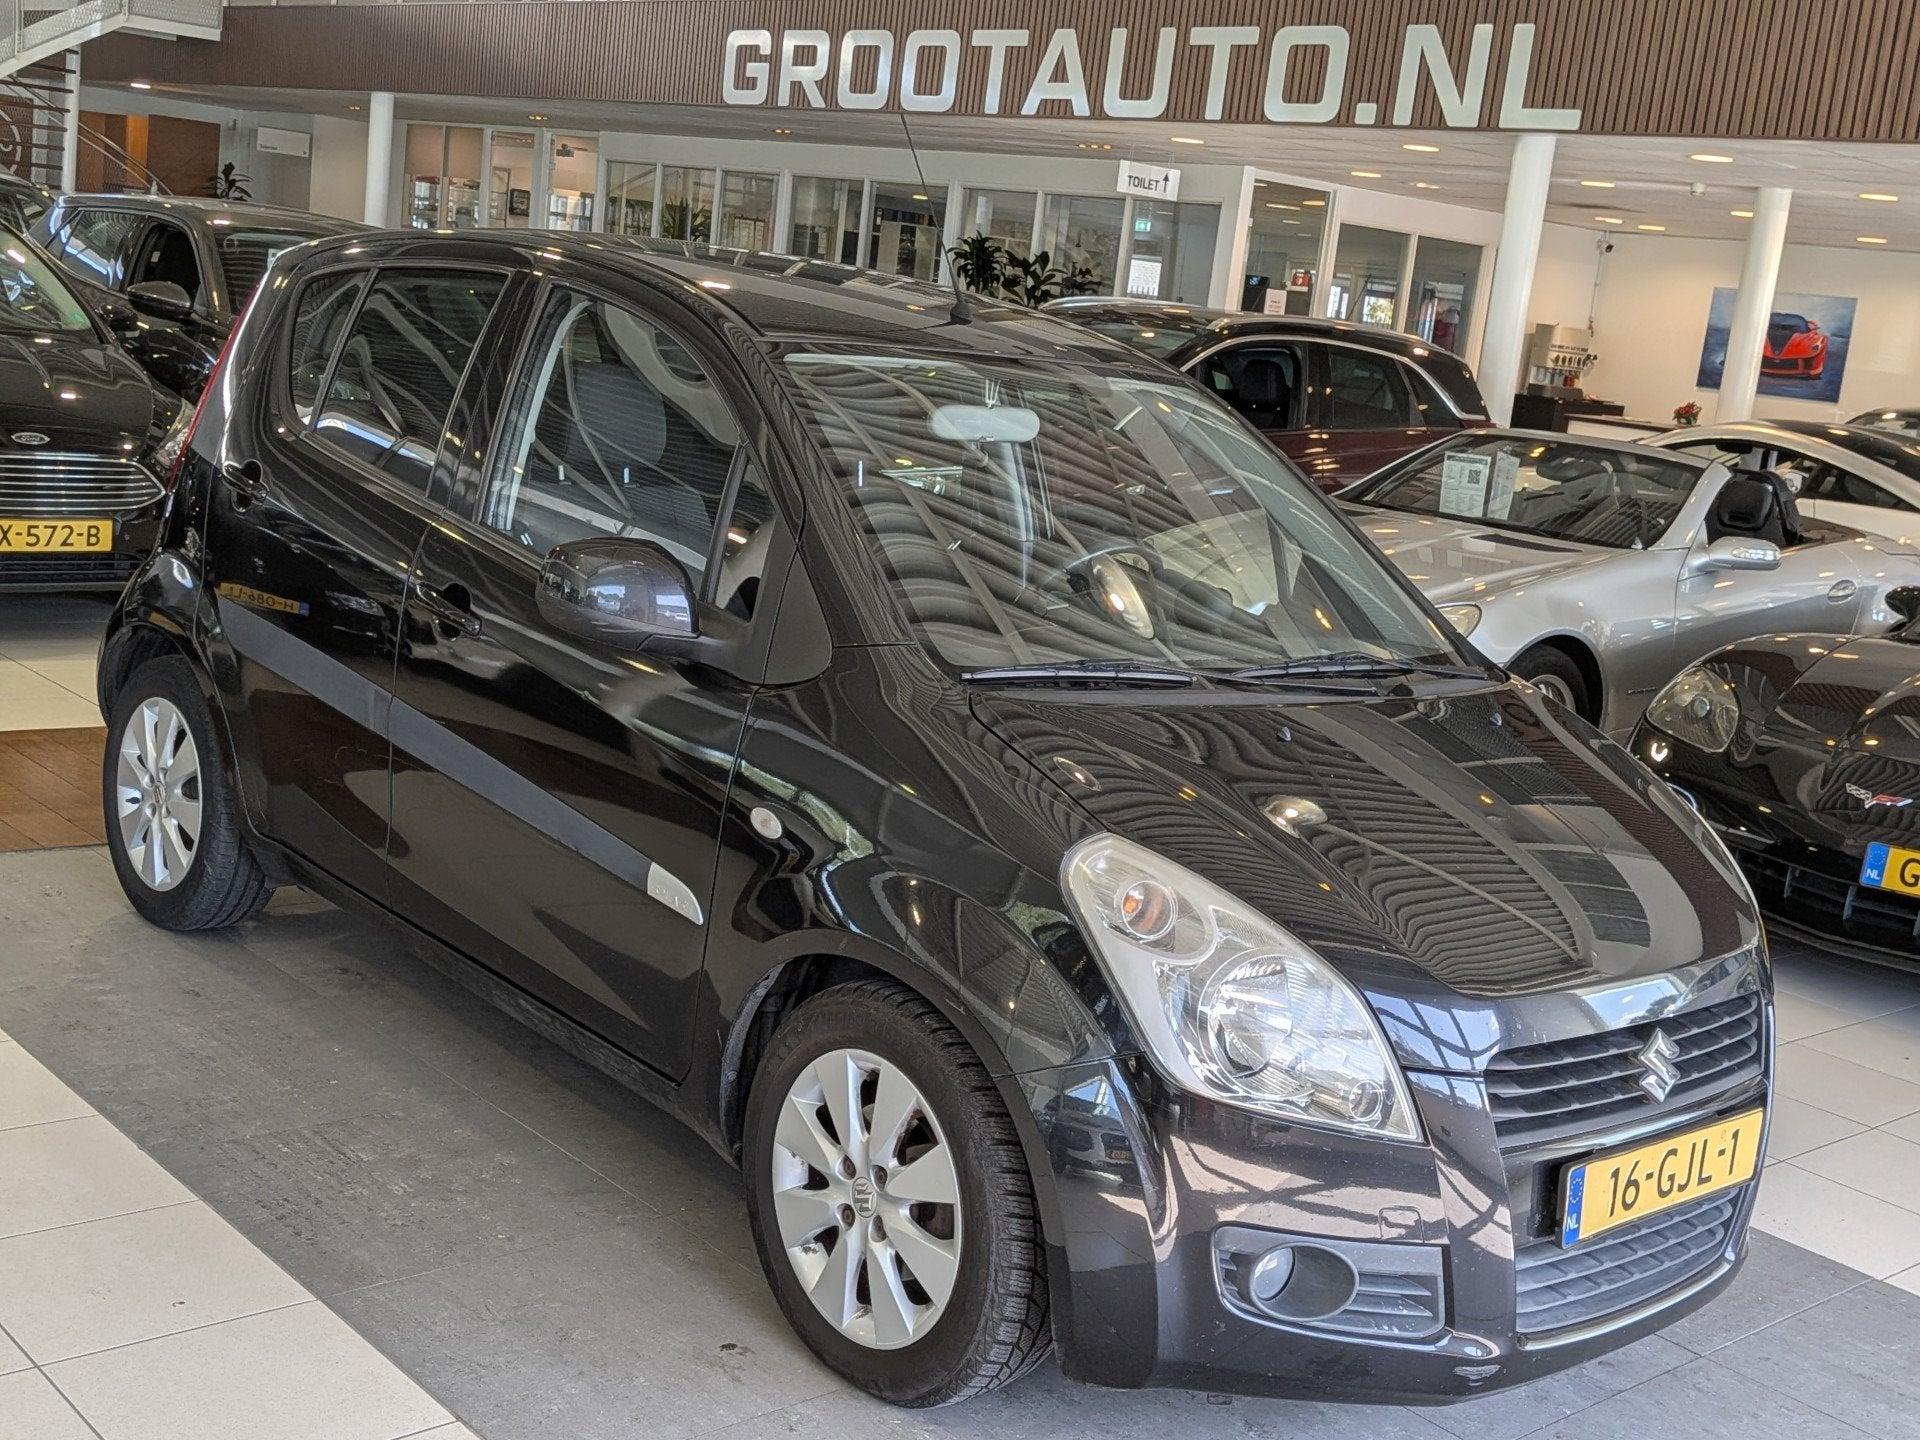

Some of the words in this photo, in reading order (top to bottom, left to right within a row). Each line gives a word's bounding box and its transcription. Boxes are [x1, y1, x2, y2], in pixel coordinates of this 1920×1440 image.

[722, 24, 1582, 130] GROOTAUTO.NL
[1128, 175, 1160, 191] TOILET
[0, 524, 101, 547] X-572-B
[1866, 868, 1881, 880] NL
[1609, 1129, 1740, 1217] 16-GJL-1
[1566, 1213, 1579, 1232] NL
